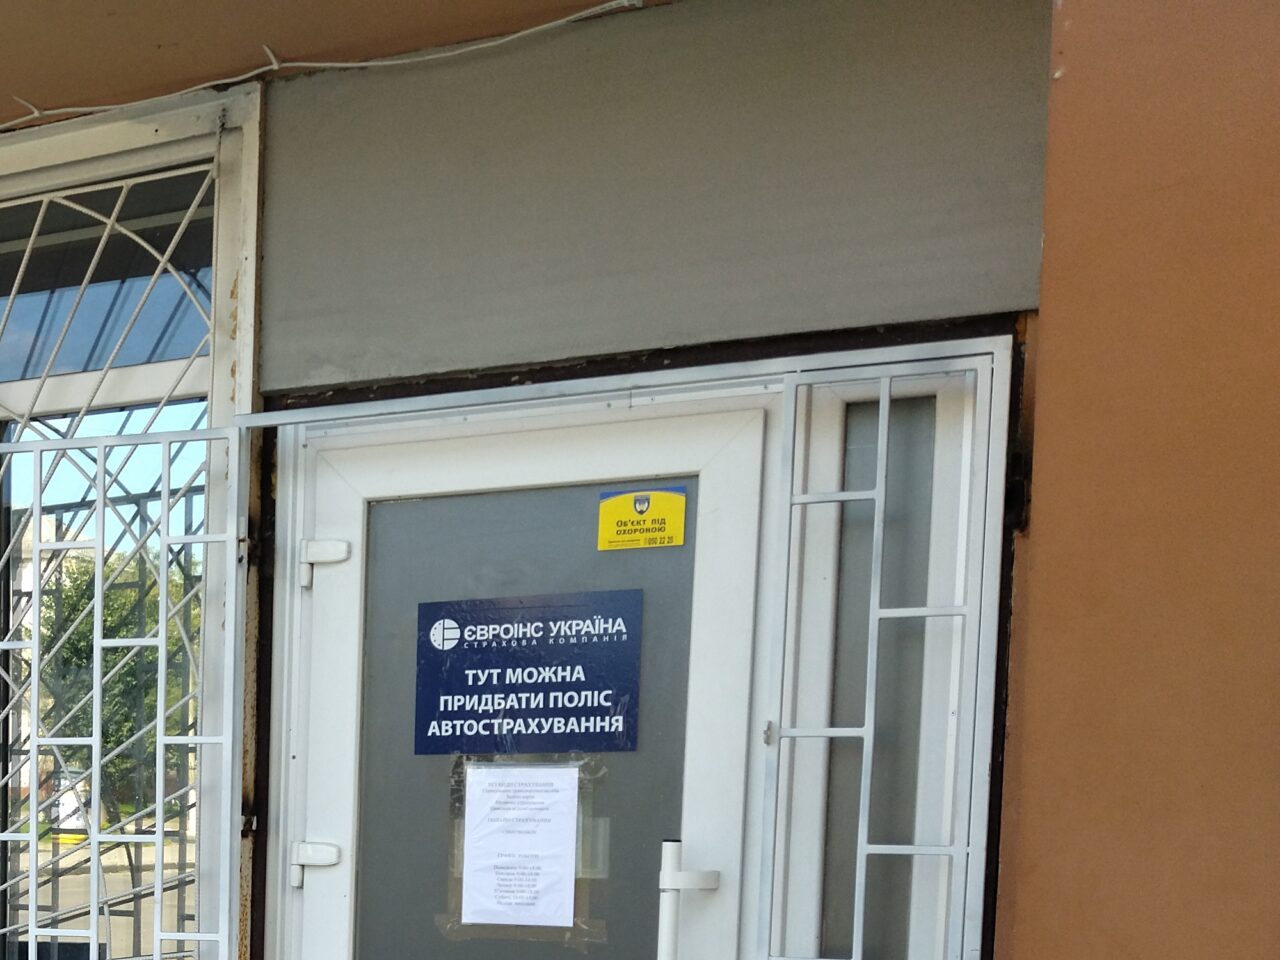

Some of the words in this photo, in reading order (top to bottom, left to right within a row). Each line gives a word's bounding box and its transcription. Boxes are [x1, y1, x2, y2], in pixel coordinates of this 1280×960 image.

[464, 621, 544, 641] ЄВРОІНС
[549, 615, 627, 637] УКРАЇНА
[463, 638, 538, 649] СТРАХОВА
[549, 634, 628, 645] КОМПАНІЯ
[465, 668, 502, 686] ТУТ
[505, 665, 586, 684] МОЖНА
[439, 692, 544, 713] ПРИДБАТИ
[549, 690, 613, 708] ПОЛІС
[427, 715, 624, 737] АВТОСТРАХУВАННЯ
